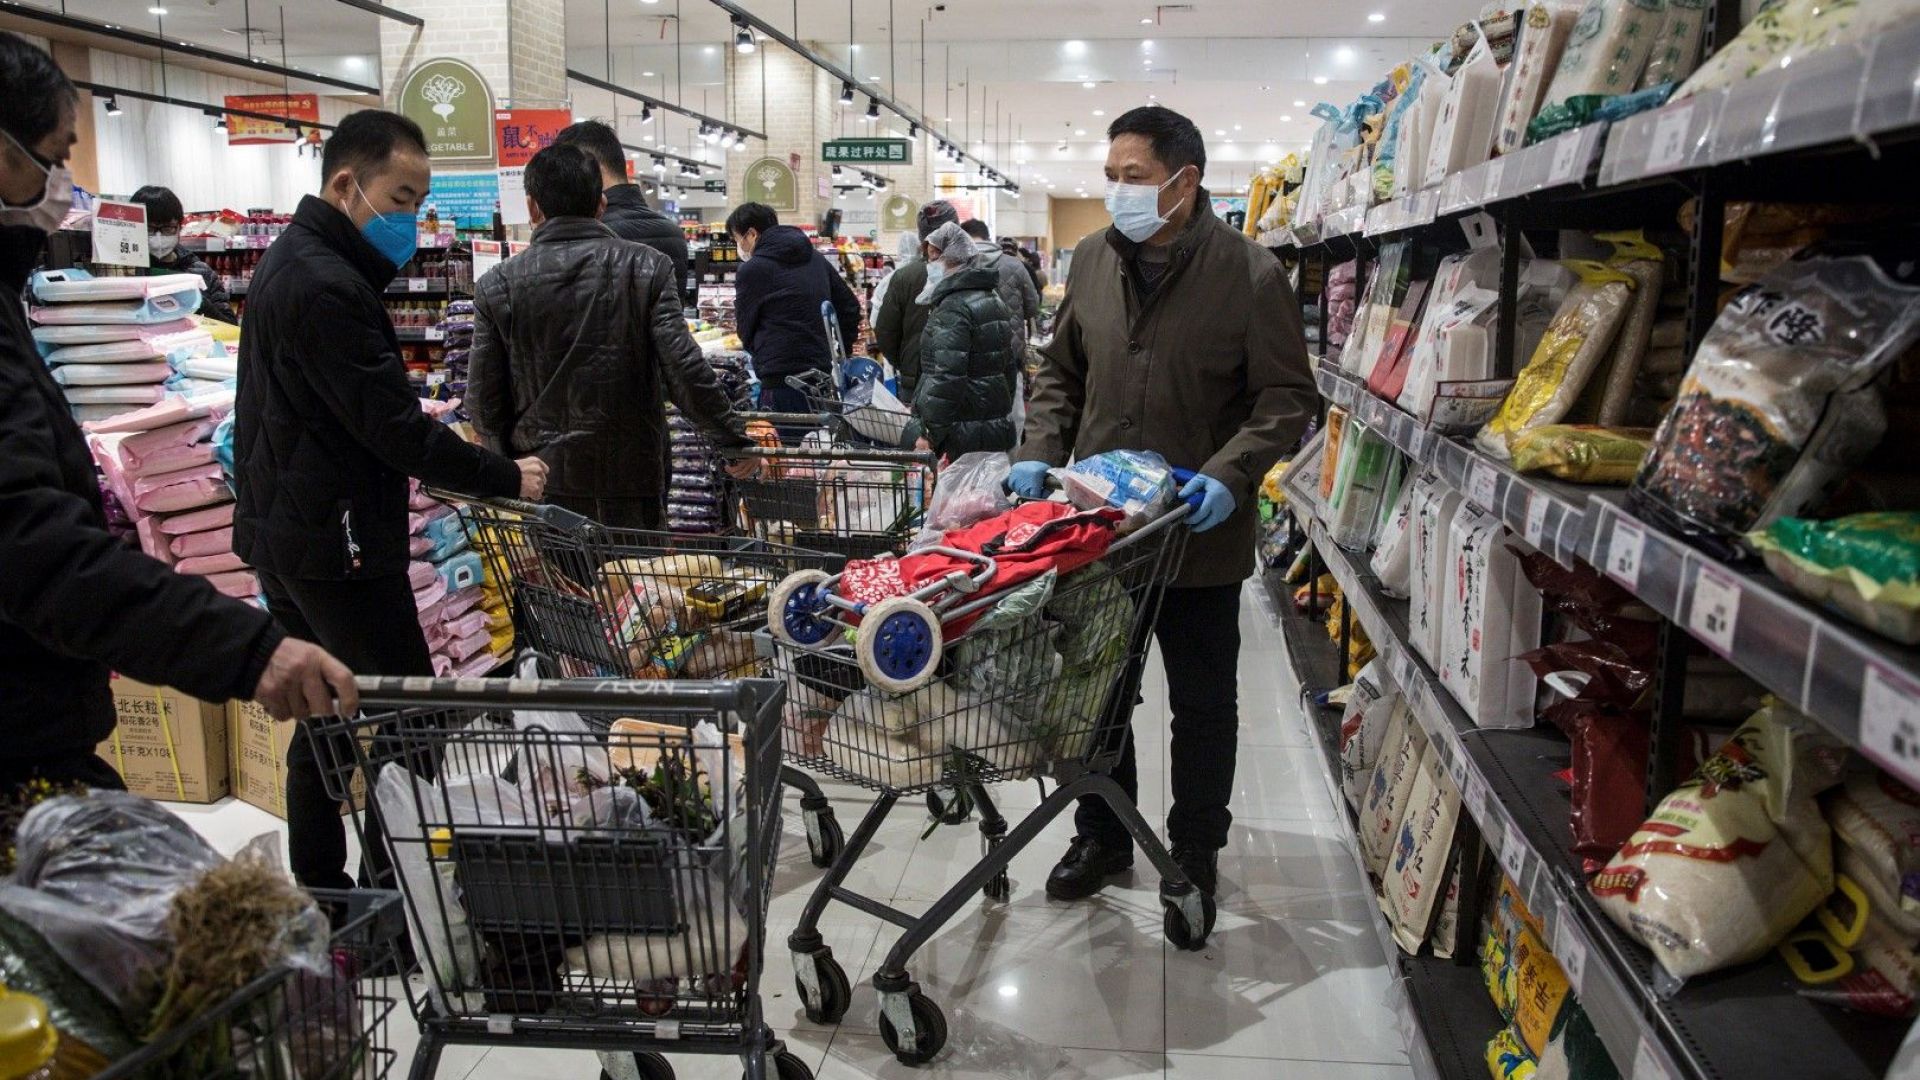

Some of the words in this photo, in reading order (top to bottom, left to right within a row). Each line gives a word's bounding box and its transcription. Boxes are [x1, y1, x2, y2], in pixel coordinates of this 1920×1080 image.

[426, 143, 474, 152] EGETABLE
[825, 146, 887, 158] 蔬果过秤处
